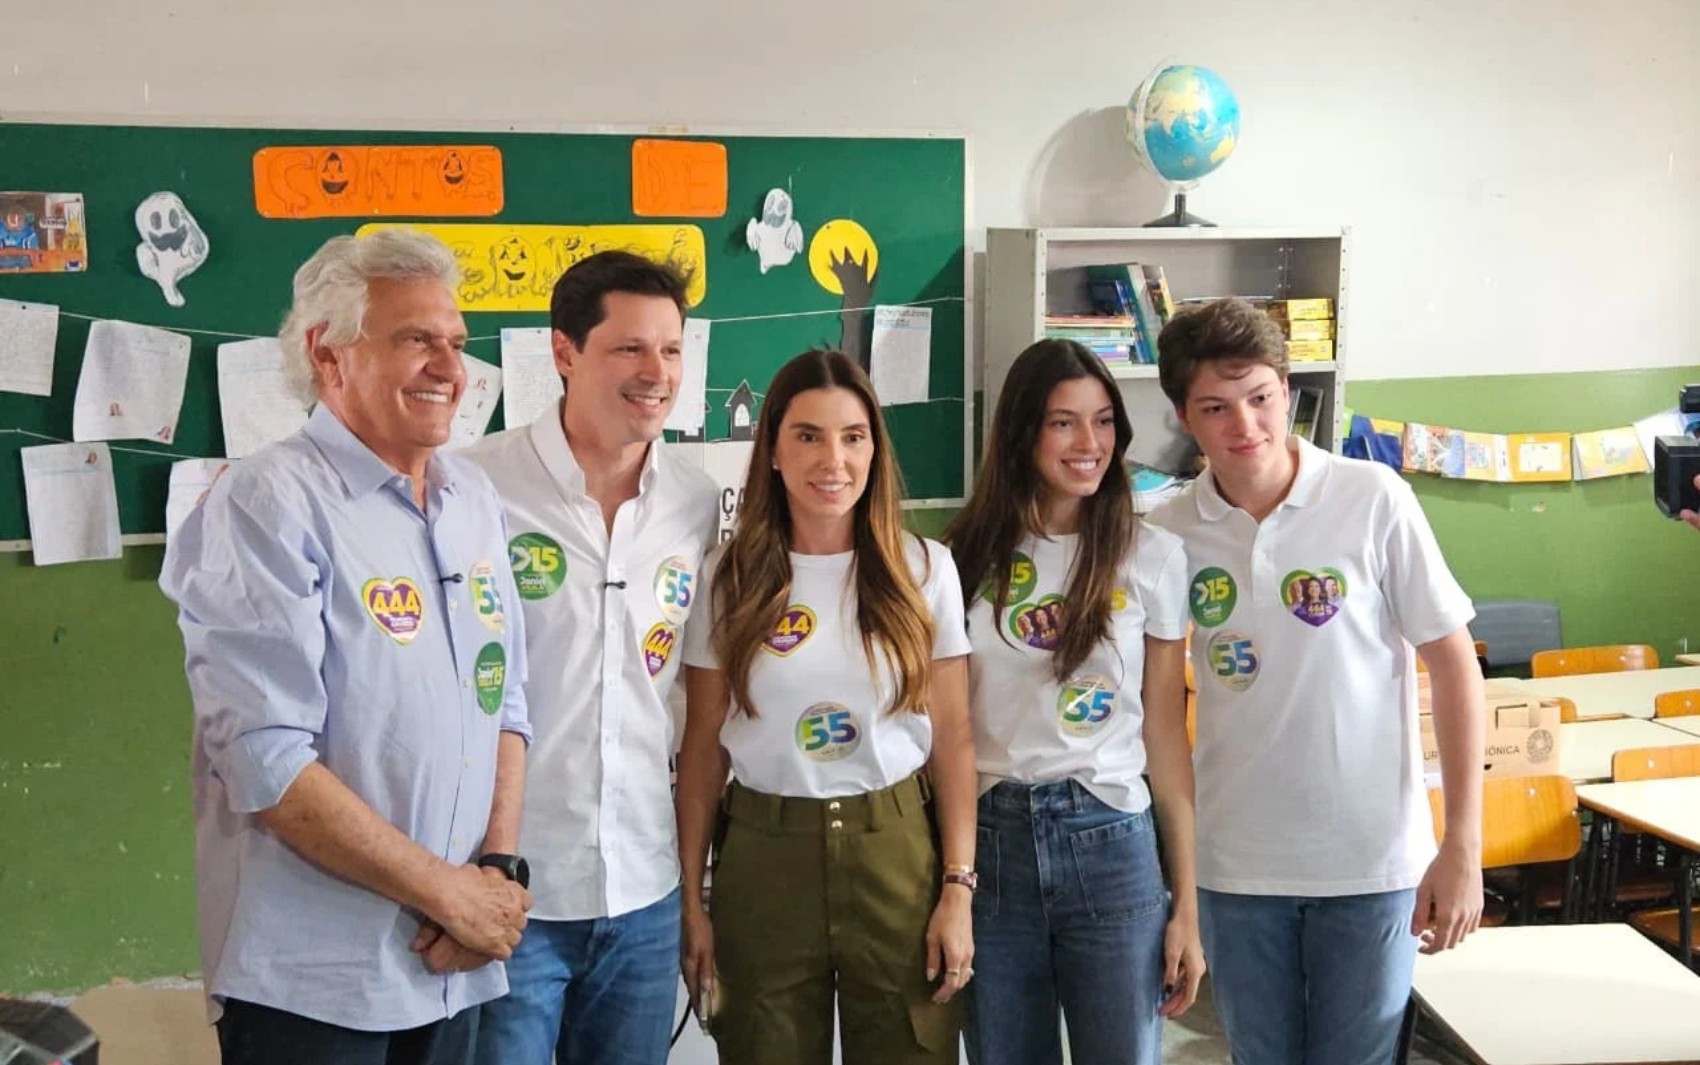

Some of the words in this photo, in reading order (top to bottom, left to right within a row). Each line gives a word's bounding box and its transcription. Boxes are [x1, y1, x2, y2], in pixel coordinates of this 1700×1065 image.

[529, 546, 559, 573] 15
[661, 566, 693, 608] 55
[1109, 587, 1127, 612] 5
[1206, 576, 1231, 602] 15
[371, 589, 421, 617] 444
[776, 614, 811, 636] 44
[1212, 640, 1257, 677] 55
[1063, 688, 1114, 723] 55
[802, 711, 857, 752] 55
